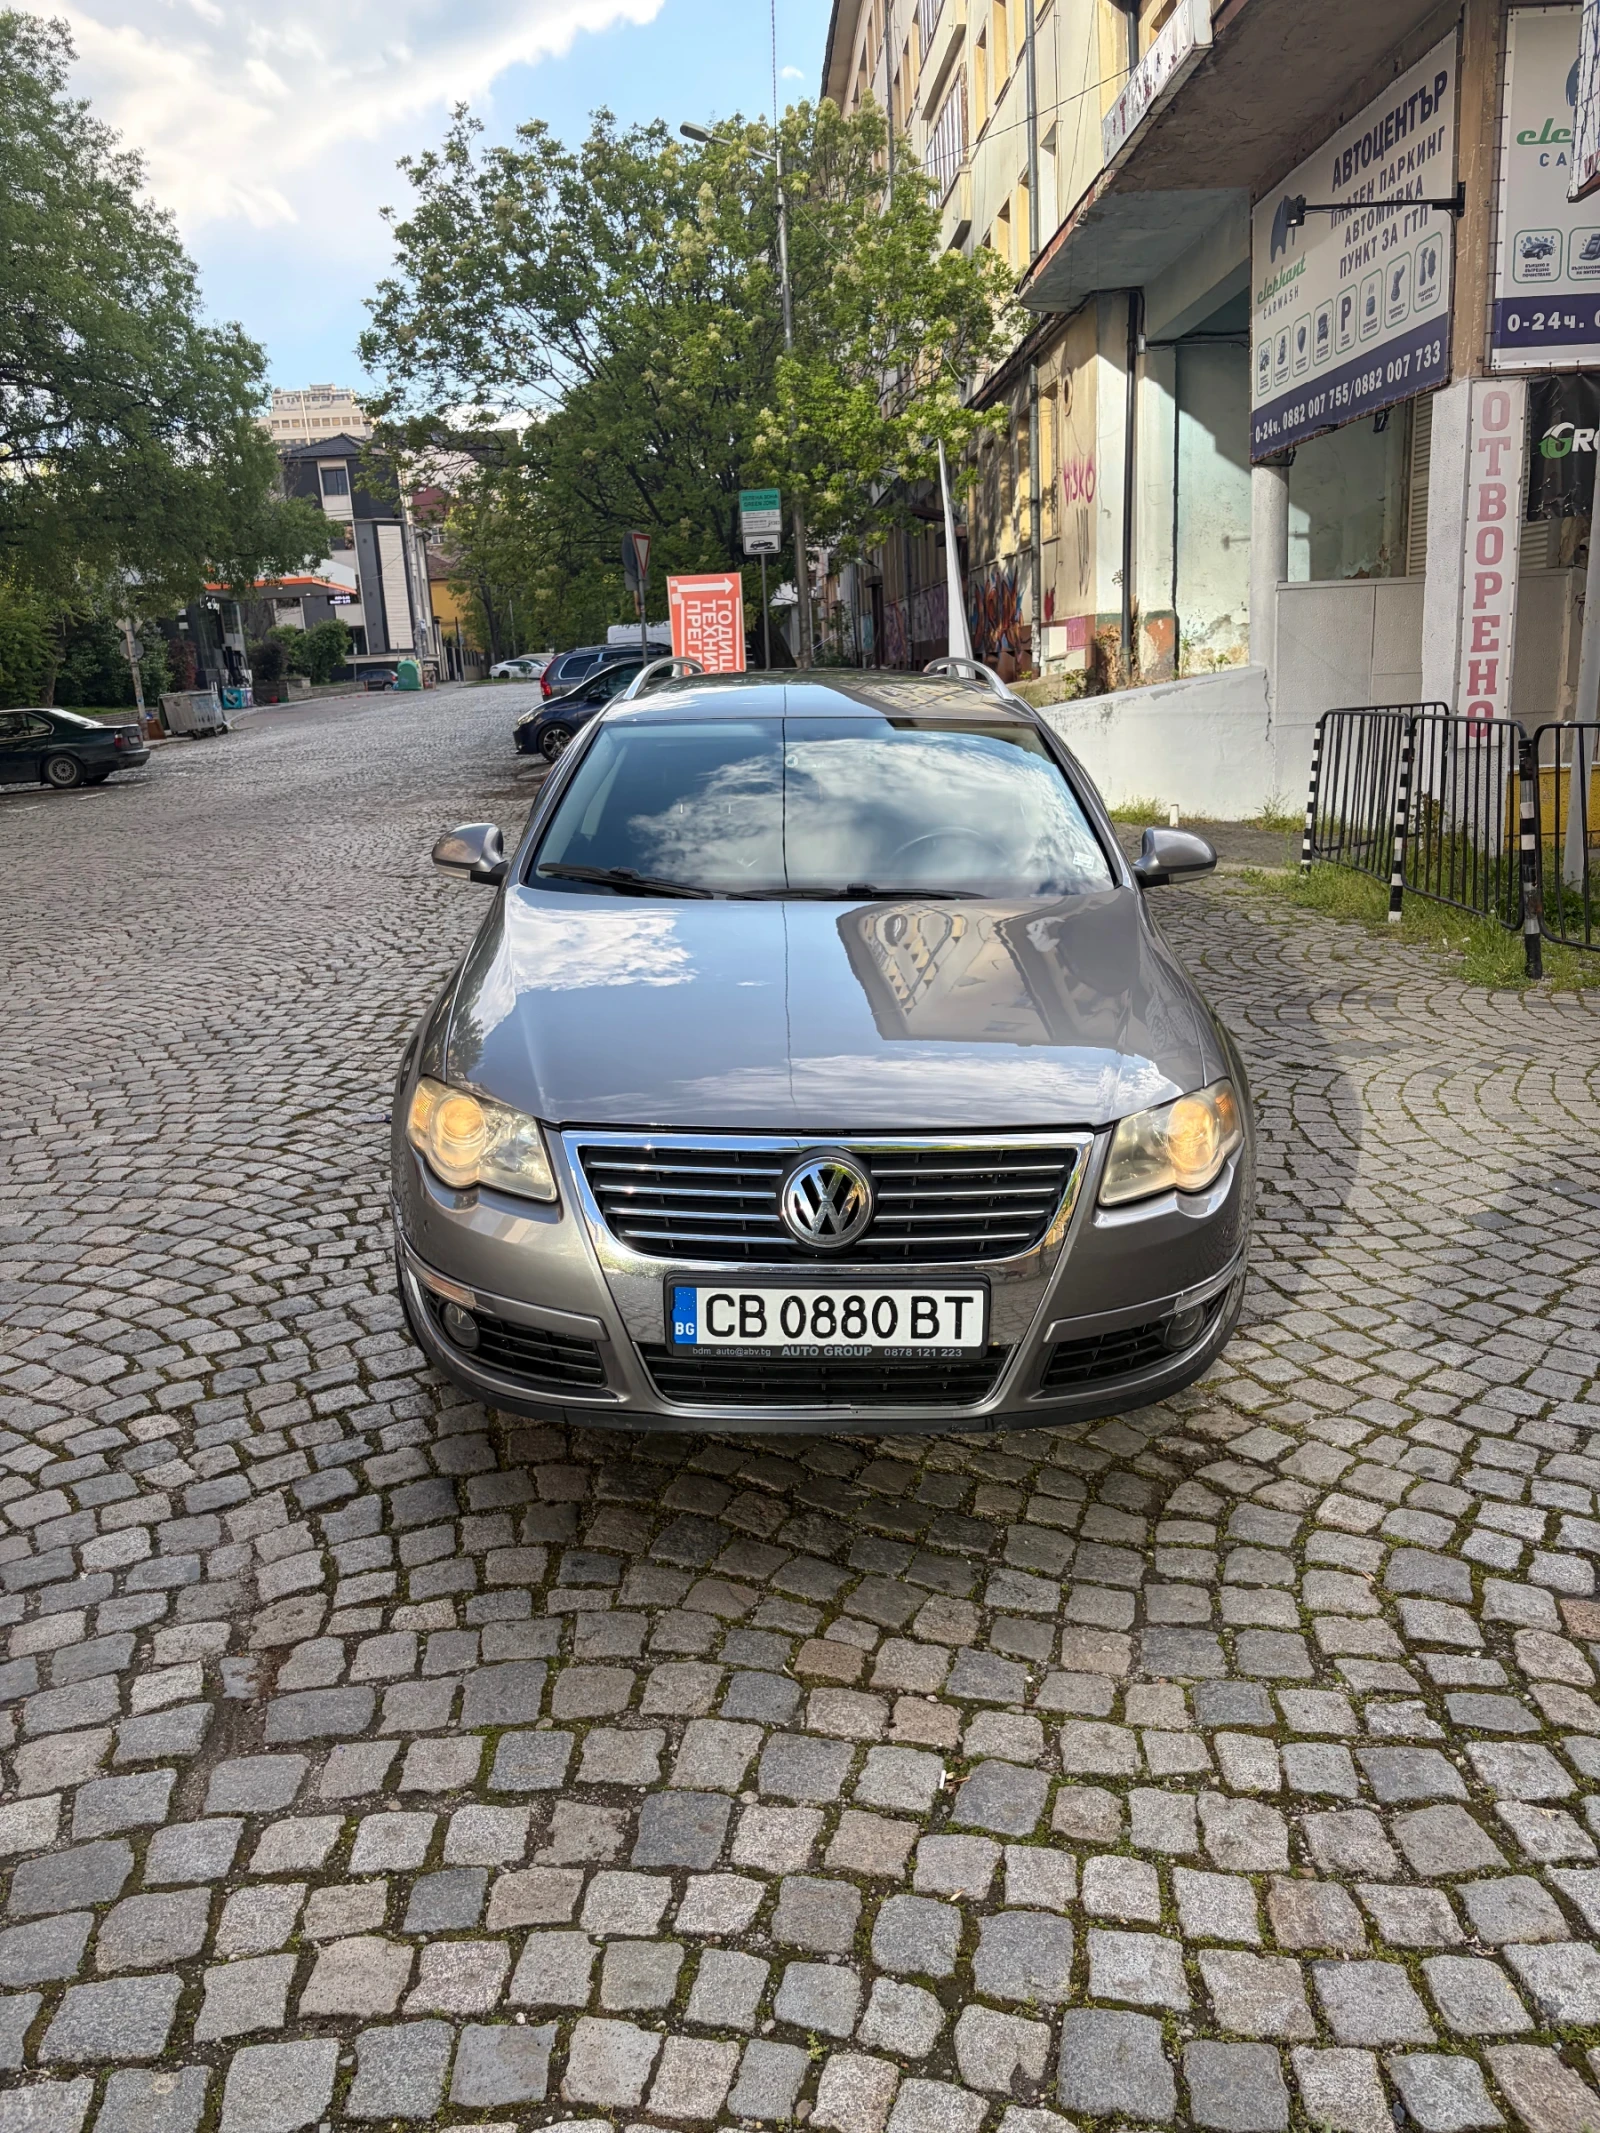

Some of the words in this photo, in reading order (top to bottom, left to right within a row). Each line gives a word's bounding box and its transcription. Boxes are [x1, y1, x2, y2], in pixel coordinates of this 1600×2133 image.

[1332, 71, 1448, 193] АВТОЦЕНТЪР
[1379, 125, 1446, 194] ПАРКИНГ
[1344, 174, 1424, 249] АВТОМИВКА
[1339, 235, 1378, 280] ПУНКТ
[1382, 222, 1398, 252] ЗА
[1403, 204, 1428, 238] ГТП
[1257, 251, 1306, 305] elephant
[1263, 285, 1299, 320] CARWASH
[1507, 311, 1585, 333] 0-24ч.
[1282, 405, 1306, 431] 0882
[1308, 393, 1326, 419] 007
[1328, 366, 1382, 409] 755/0882
[1386, 353, 1411, 384] 007
[1415, 339, 1441, 372] 733
[1538, 422, 1599, 459] GR
[1466, 390, 1511, 739] ОТВОРЕНО
[674, 1322, 695, 1336] BG
[705, 1293, 767, 1338] CB
[780, 1294, 899, 1339] 0880
[910, 1295, 974, 1340] BT
[692, 1347, 771, 1357] bdm_auto@abv.bg
[781, 1346, 820, 1357] AUTO
[823, 1346, 873, 1357] GROUP
[884, 1348, 914, 1357] 0878
[916, 1348, 936, 1357] 121
[940, 1348, 963, 1357] 223
